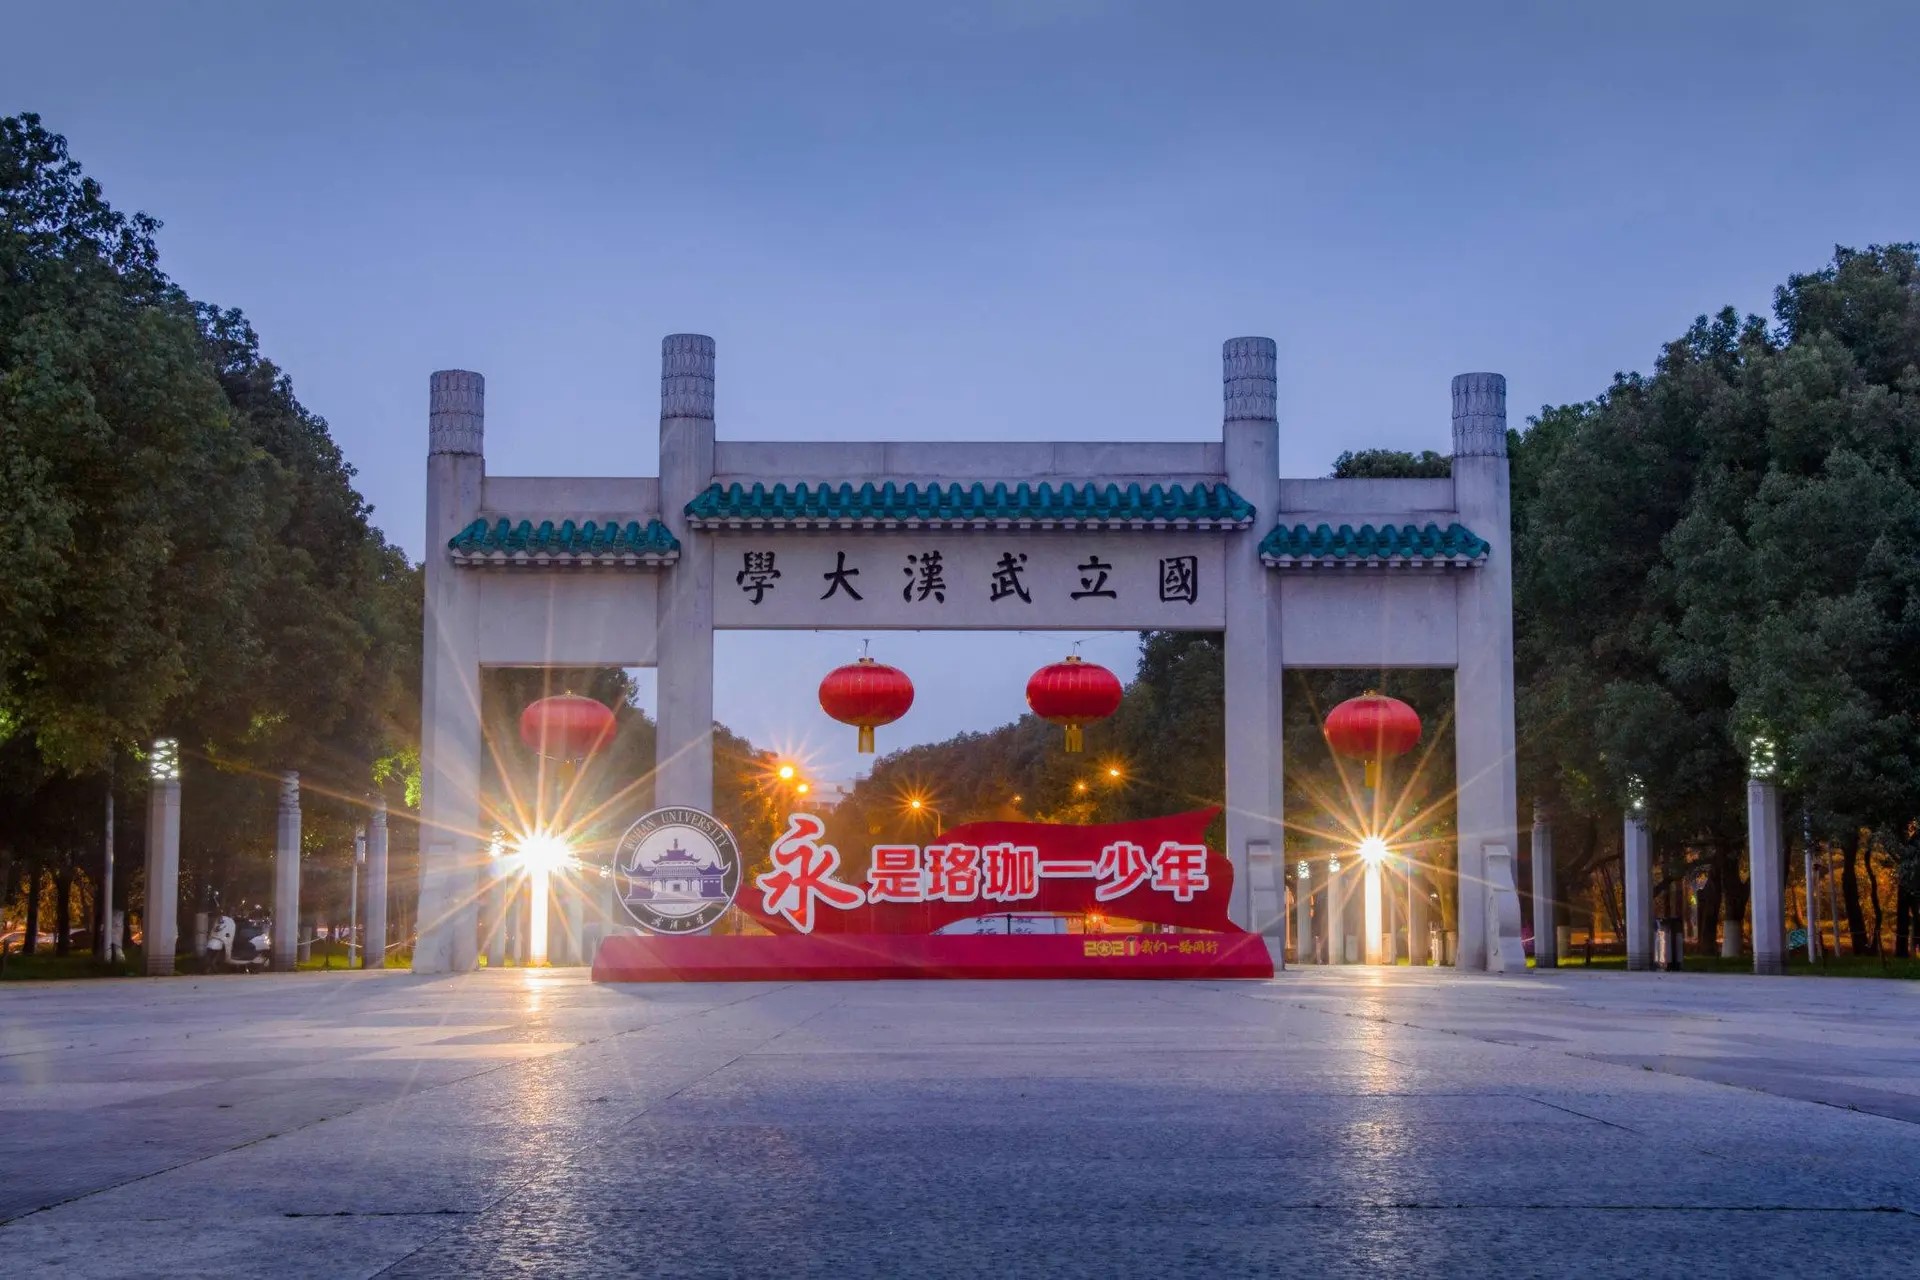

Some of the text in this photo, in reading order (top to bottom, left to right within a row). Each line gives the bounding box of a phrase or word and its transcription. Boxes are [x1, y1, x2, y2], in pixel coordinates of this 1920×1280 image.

[736, 550, 1196, 605] 國立武漢大學
[624, 811, 729, 849] WUHAN UNIVERSITY
[758, 813, 1208, 933] 永是珞珈一少年
